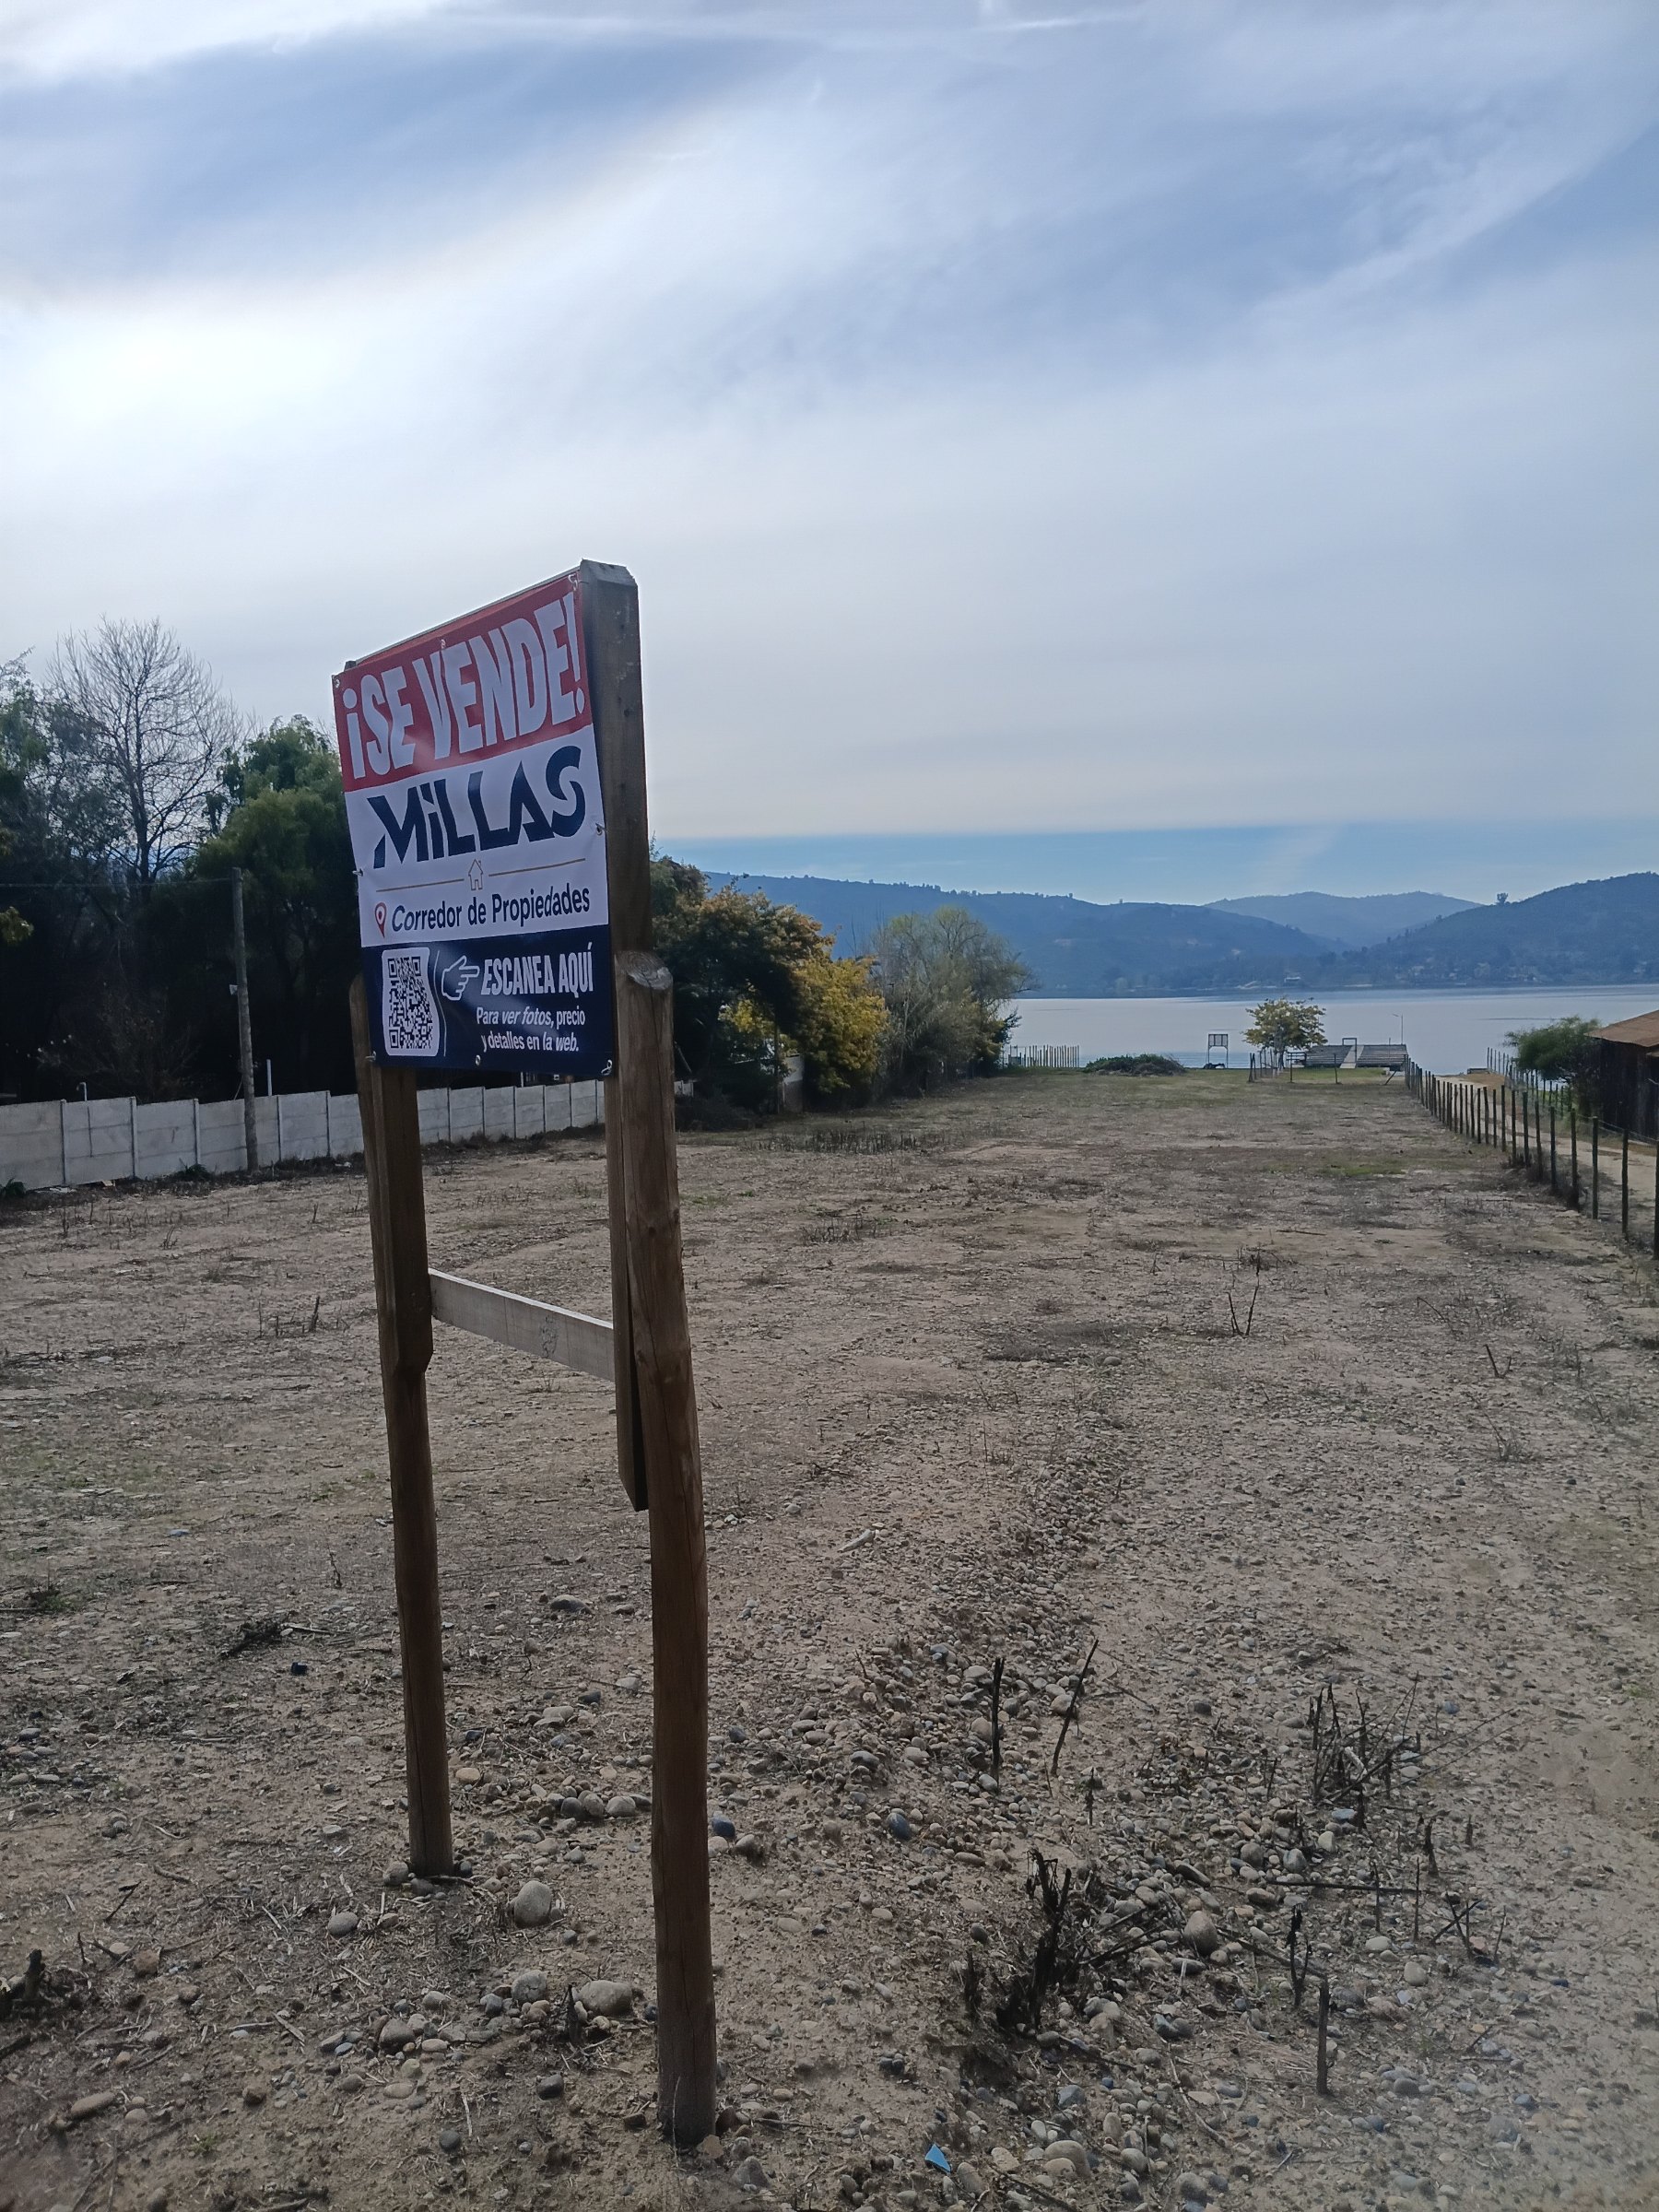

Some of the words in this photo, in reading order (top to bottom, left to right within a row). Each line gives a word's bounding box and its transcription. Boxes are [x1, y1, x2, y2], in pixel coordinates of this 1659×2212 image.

[343, 666, 416, 779] ¡SE
[412, 591, 585, 760] VENDE!
[392, 900, 462, 933] Corredor
[467, 896, 487, 925] de
[491, 883, 590, 927] Propiedades
[480, 956, 555, 995] ESCANEA
[559, 941, 594, 998] AQUÍ
[477, 1006, 499, 1026] Para
[501, 1010, 521, 1025] ver
[521, 1006, 555, 1030] fotos,
[557, 1005, 586, 1029] precio
[480, 1034, 488, 1053] y
[488, 1030, 525, 1050] detalles
[526, 1035, 540, 1051] en
[542, 1032, 553, 1052] la
[555, 1032, 579, 1052] web.
